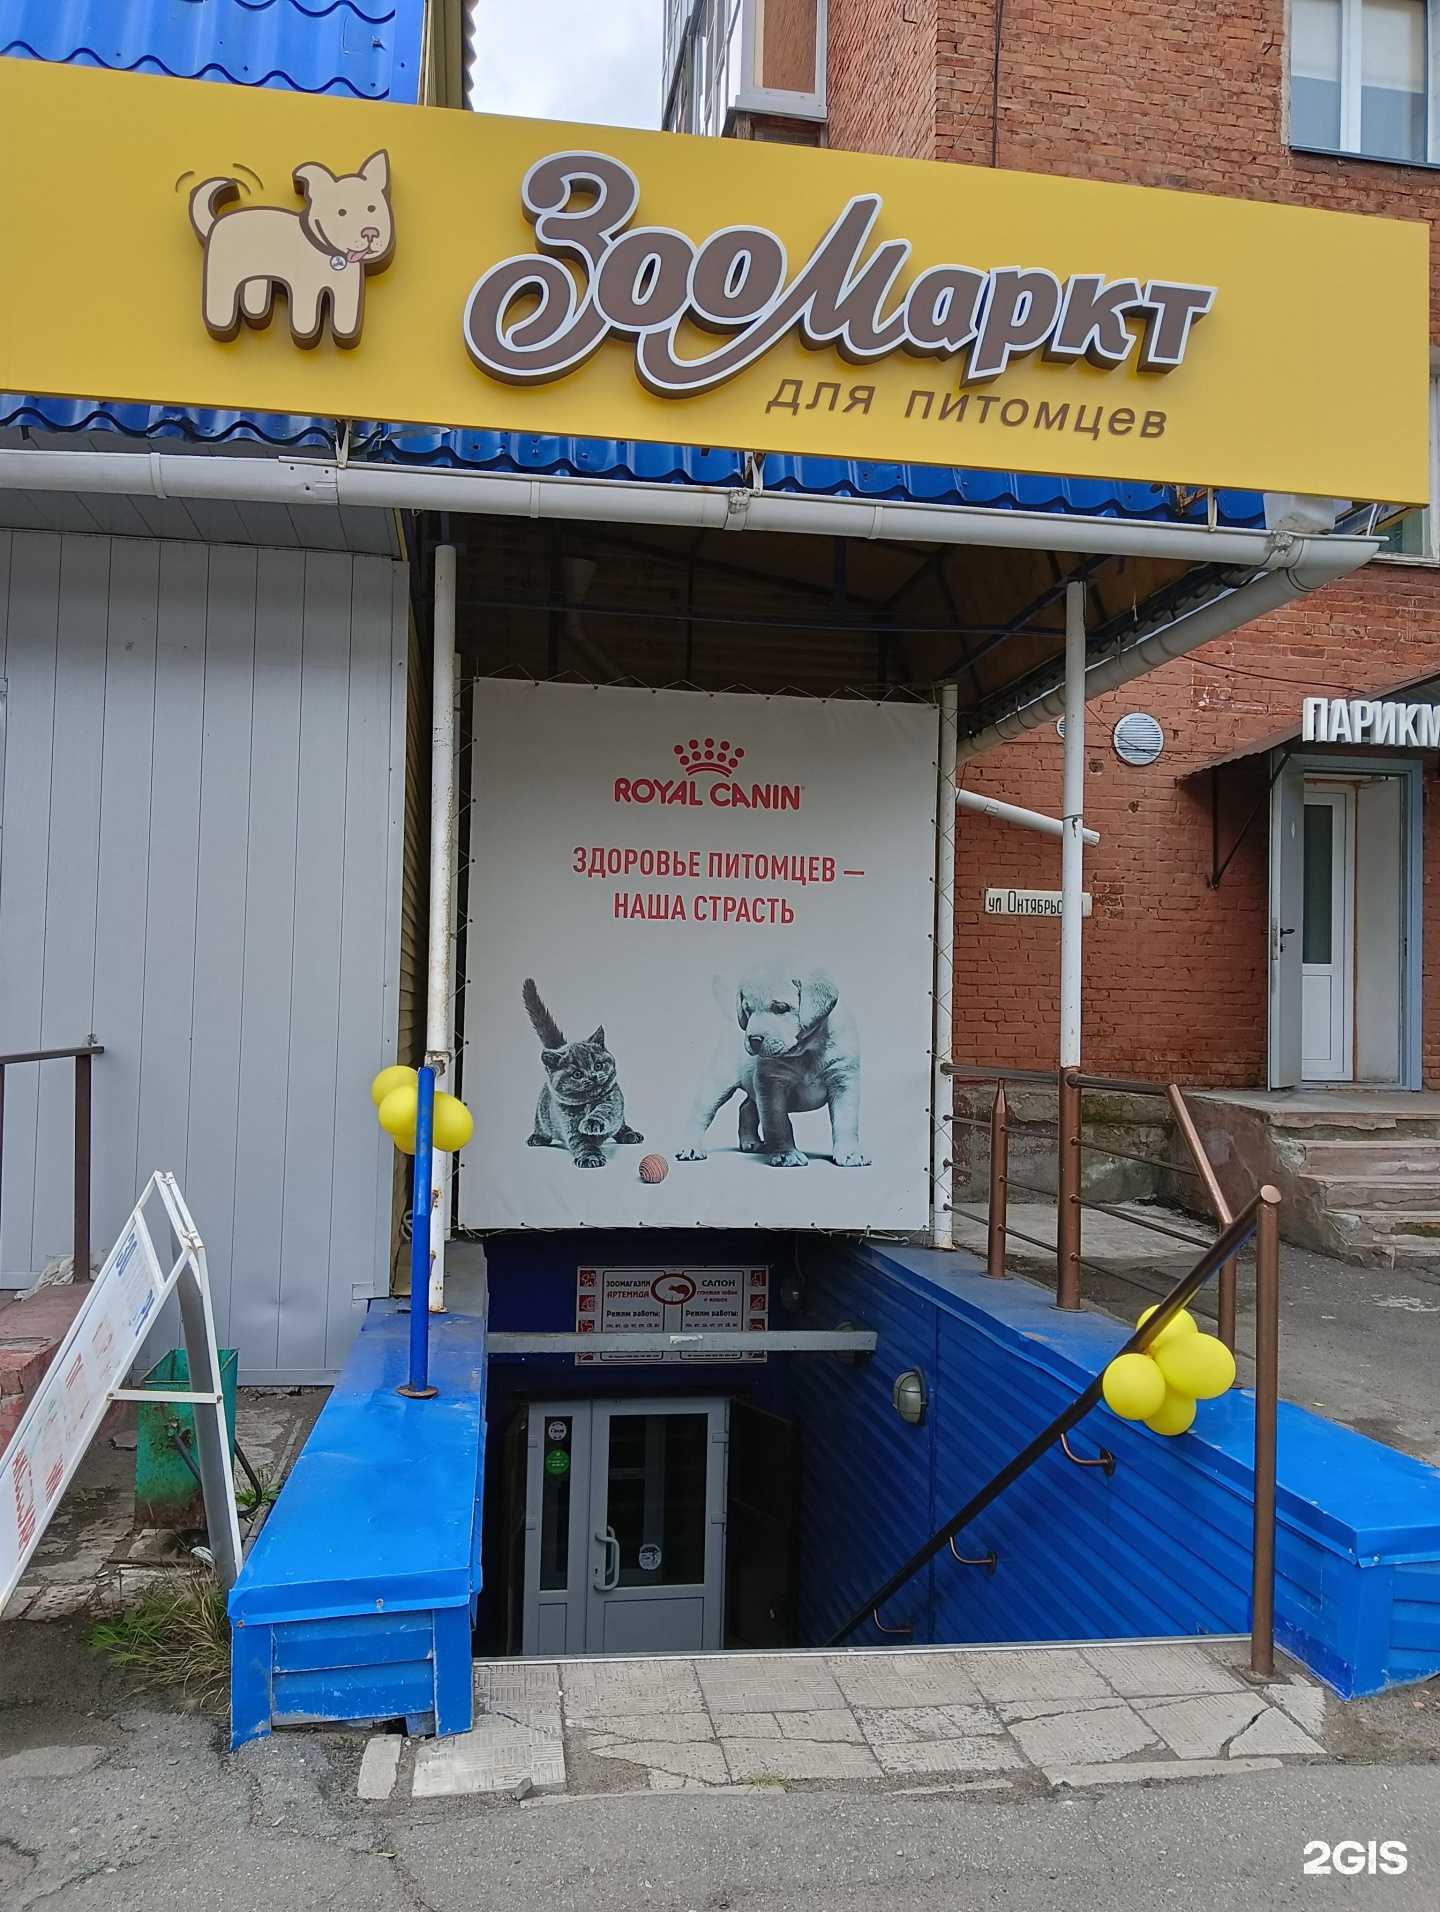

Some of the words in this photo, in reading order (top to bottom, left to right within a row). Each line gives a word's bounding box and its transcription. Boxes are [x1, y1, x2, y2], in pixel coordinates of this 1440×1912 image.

[463, 149, 1218, 397] ЗооМаркт
[766, 378, 876, 415] для
[904, 390, 1169, 440] питомцев
[613, 777, 704, 806] ROYAL
[709, 782, 800, 810] CANIN
[572, 846, 701, 879] ЗДОРОВЬЕ
[708, 852, 836, 886] ПИТОМЦЕВ
[613, 893, 687, 921] НАША
[693, 895, 796, 924] СТРАСТЬ
[1007, 890, 1083, 914] Октябрьс
[702, 1279, 736, 1287] САЛОН
